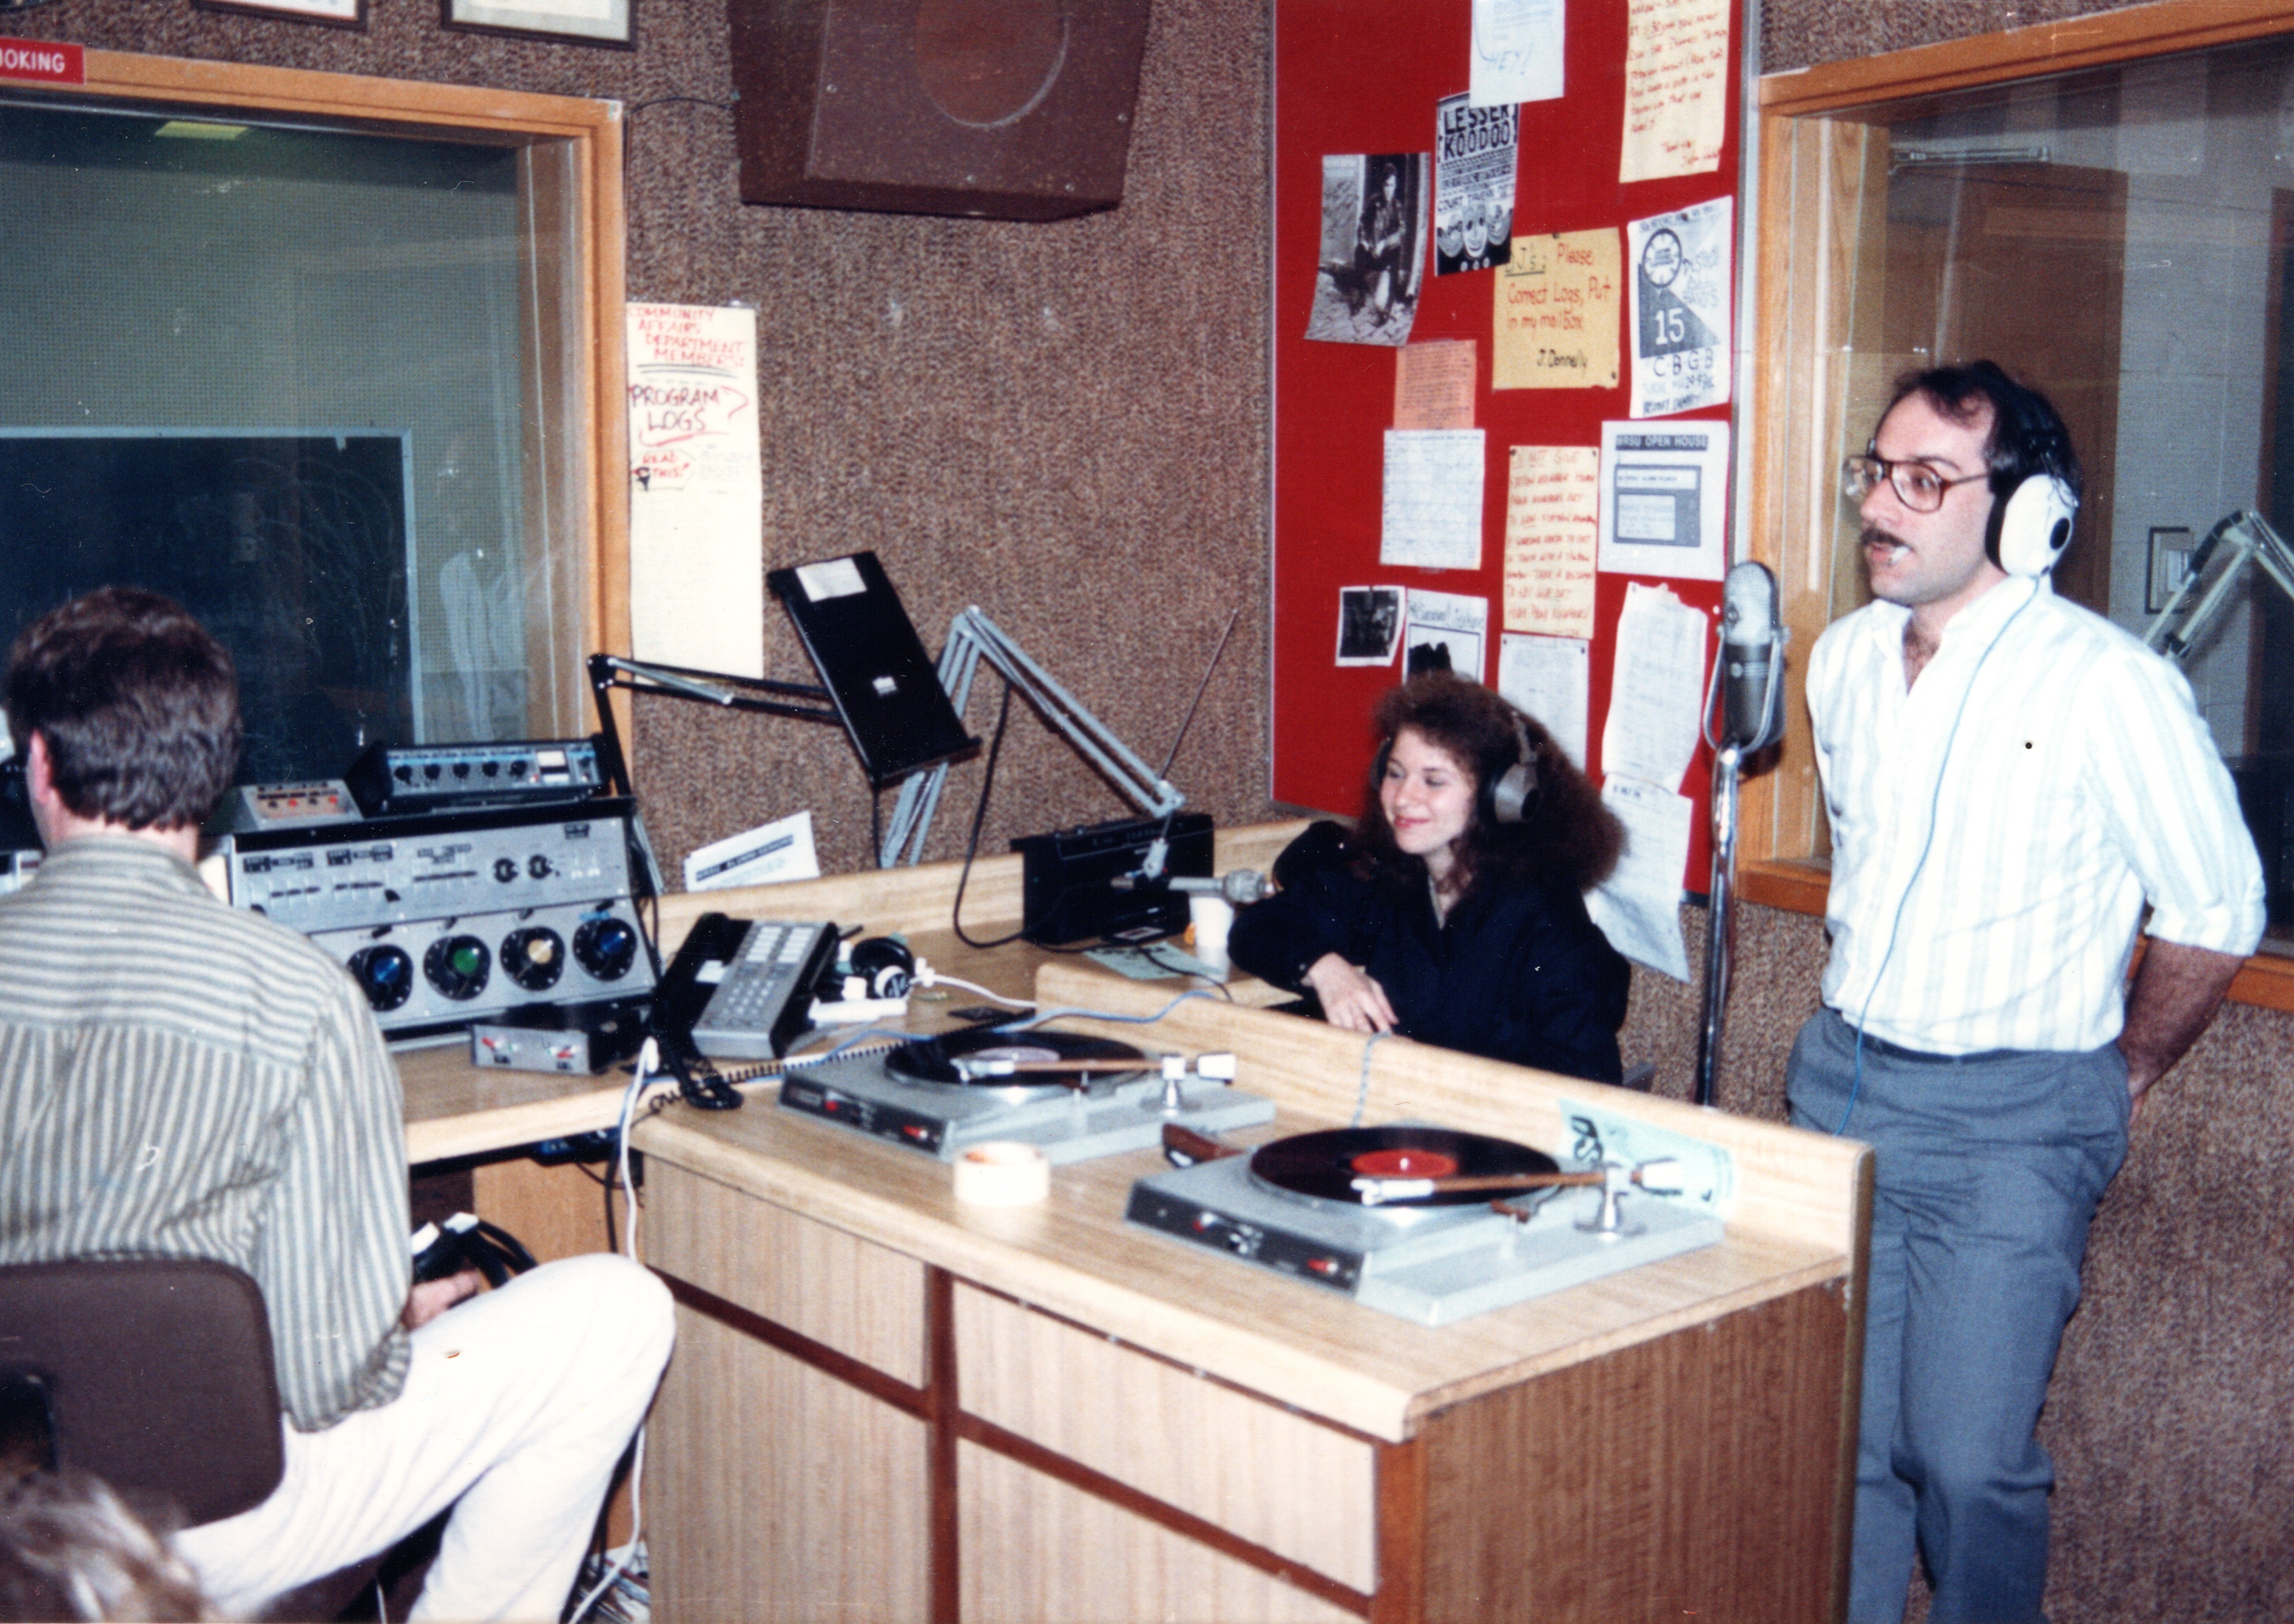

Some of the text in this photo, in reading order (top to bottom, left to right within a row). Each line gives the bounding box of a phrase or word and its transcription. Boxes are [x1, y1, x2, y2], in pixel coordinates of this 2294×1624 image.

[0, 48, 65, 74] OKING
[1444, 120, 1510, 160] KOODOO
[630, 306, 715, 321] COMMUNITY
[639, 319, 701, 334] AFFAIRS
[1655, 307, 1685, 346] 15
[645, 333, 744, 353] DEPARTMENT
[631, 384, 720, 408] PROGRAM
[648, 407, 706, 431] LOGS
[1644, 435, 1671, 447] OPEN
[1674, 435, 1708, 447] HOUSE
